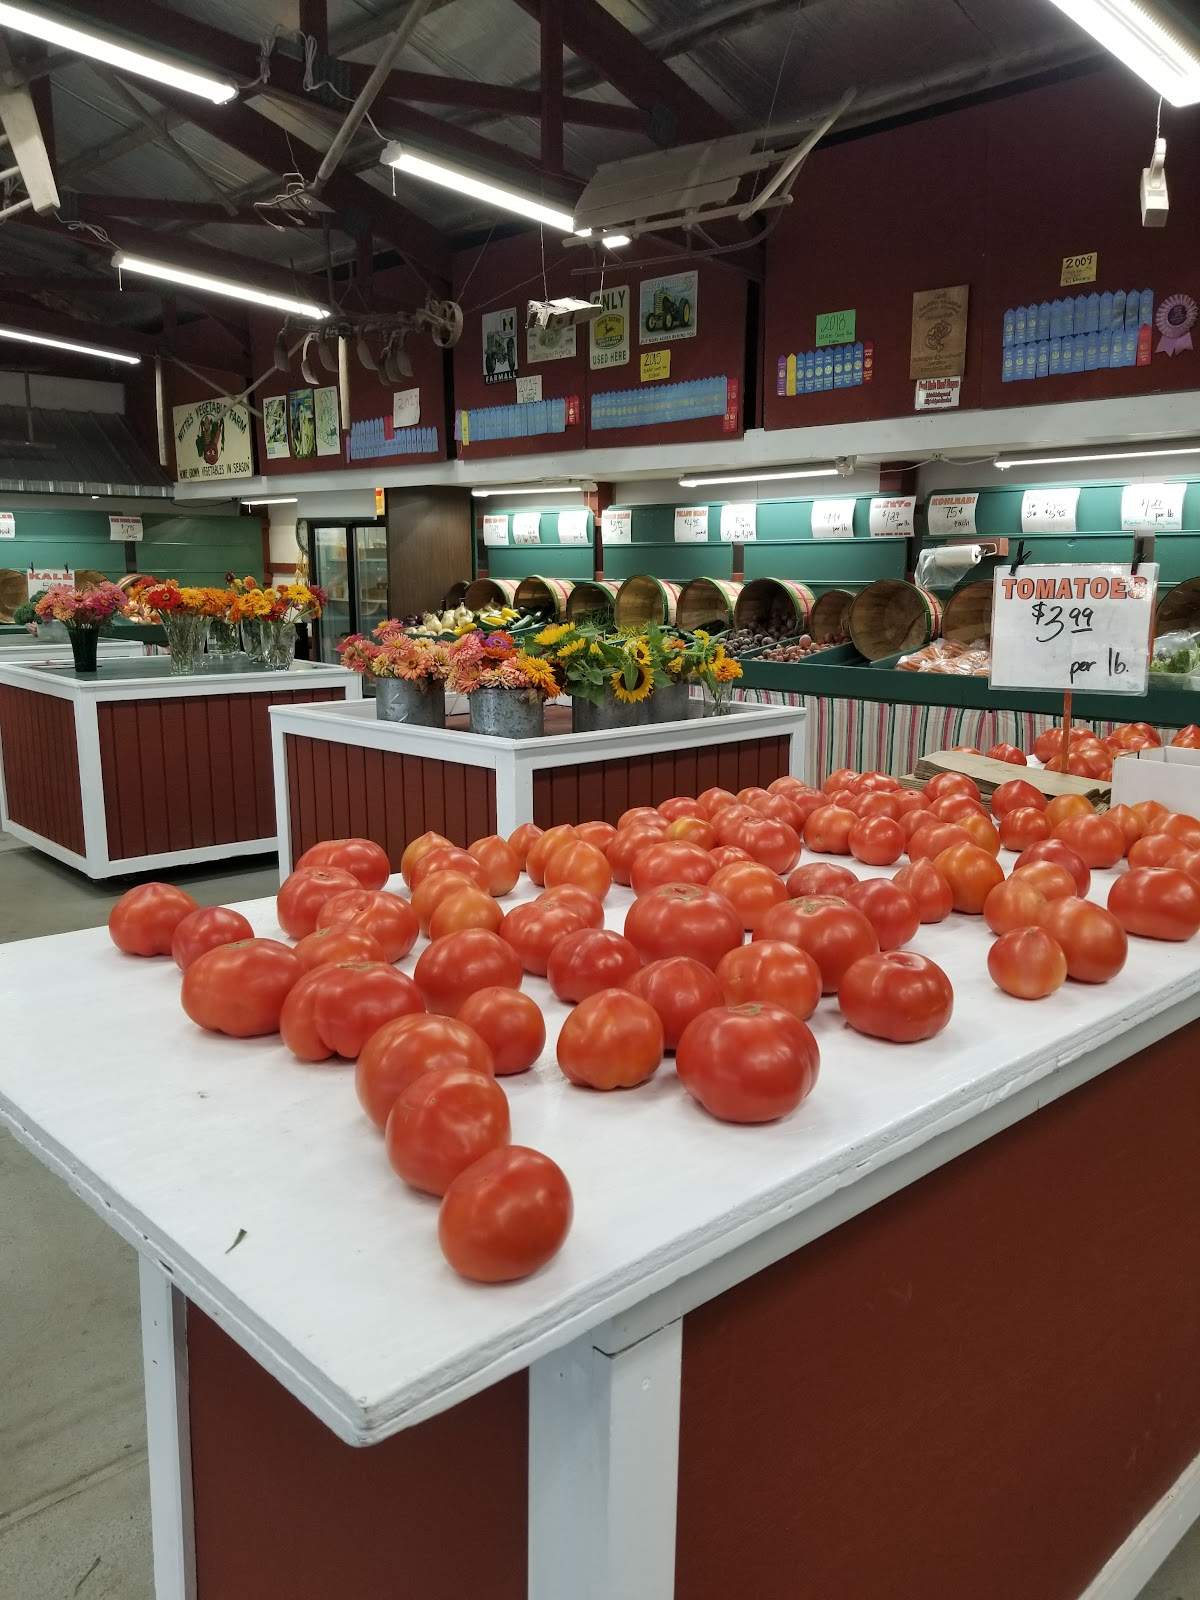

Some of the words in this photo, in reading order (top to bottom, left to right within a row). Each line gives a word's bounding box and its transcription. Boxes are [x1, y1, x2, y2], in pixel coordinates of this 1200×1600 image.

[1065, 255, 1093, 269] 2009
[592, 353, 608, 365] USED
[610, 351, 627, 361] HERE
[229, 409, 247, 434] FARM
[1069, 660, 1096, 685] per
